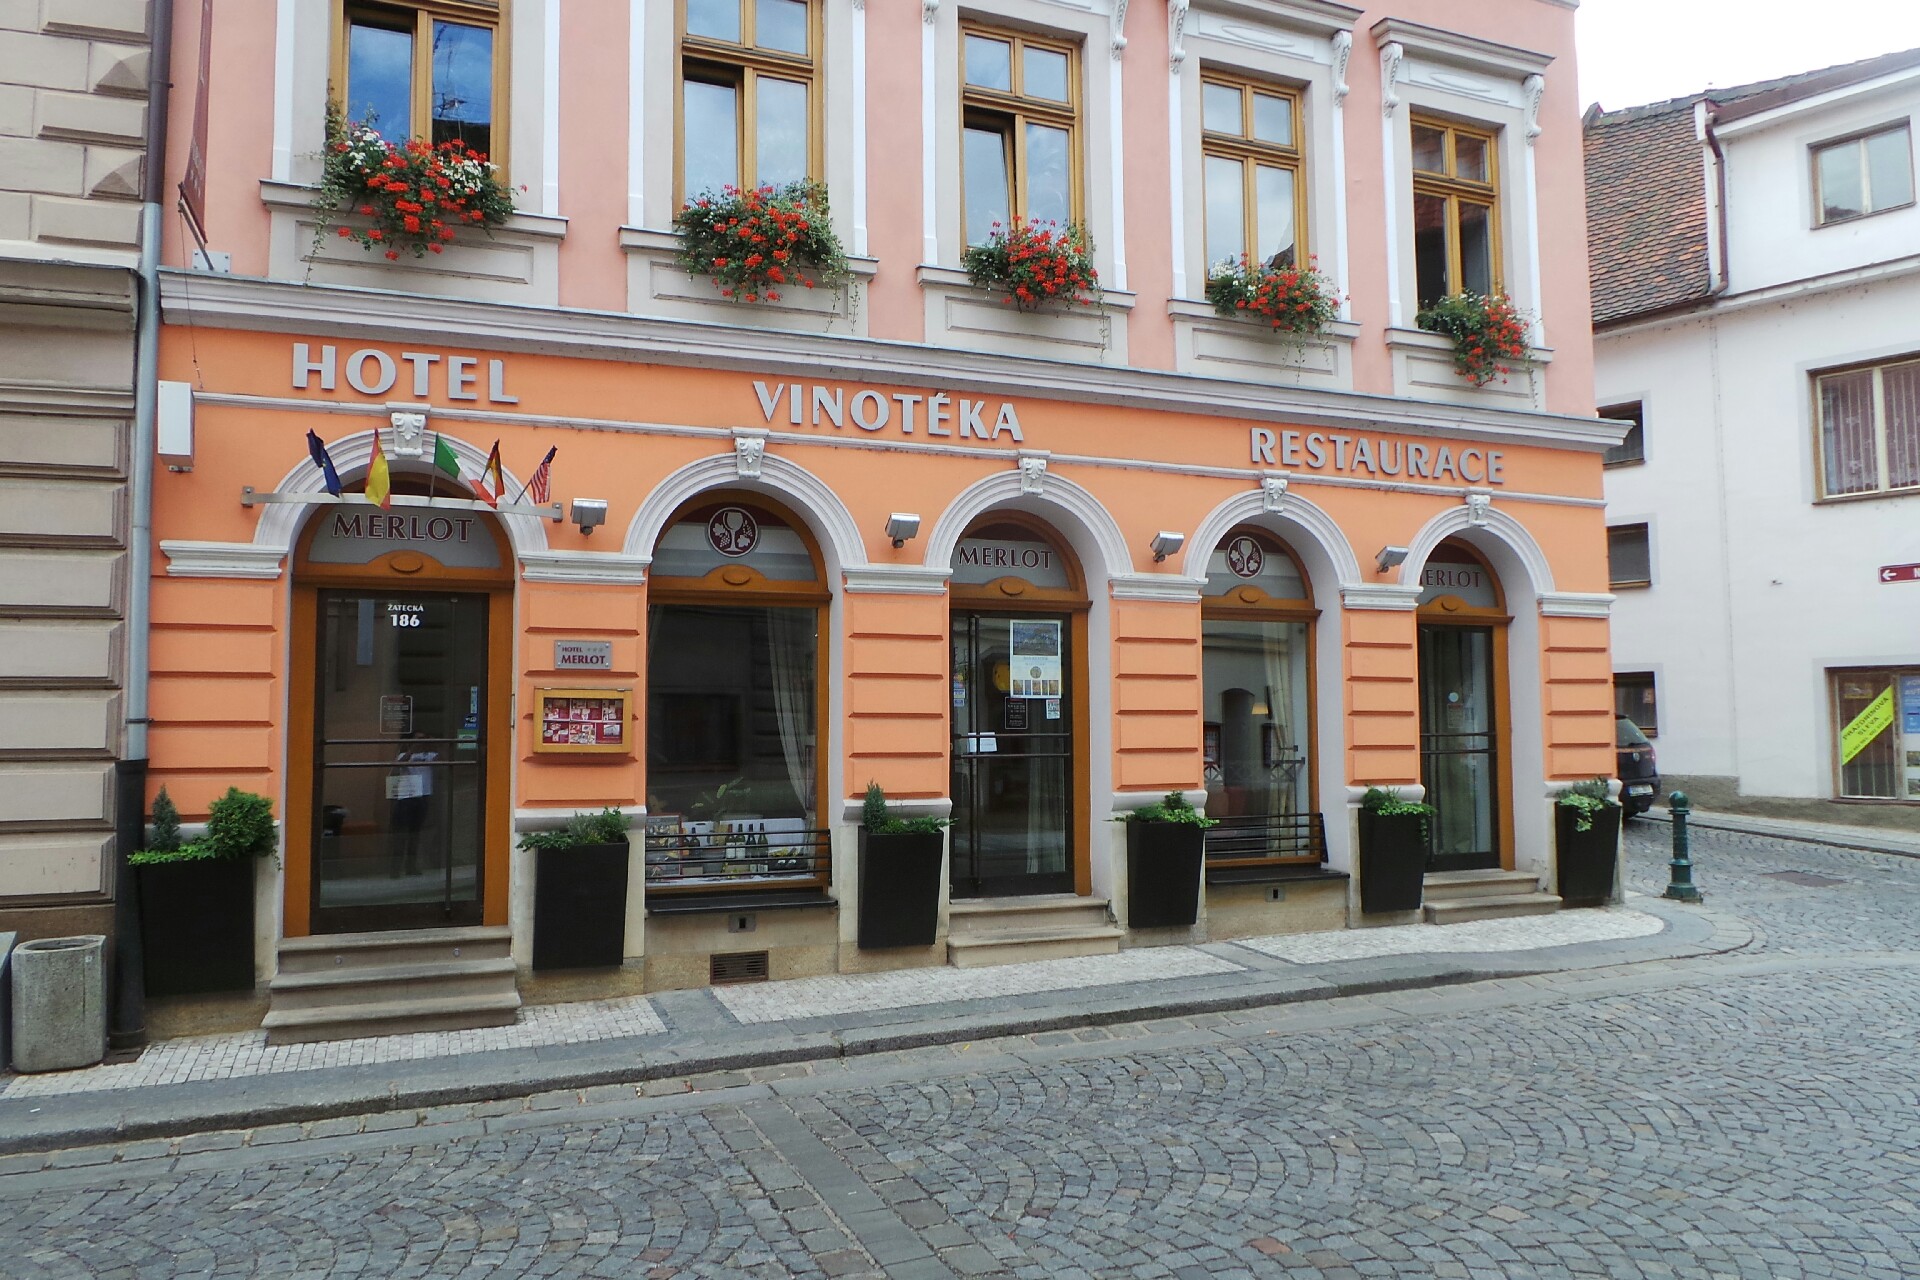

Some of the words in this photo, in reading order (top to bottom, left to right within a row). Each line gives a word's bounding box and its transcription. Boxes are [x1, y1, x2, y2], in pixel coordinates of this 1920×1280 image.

[292, 342, 519, 403] HOTEL
[753, 381, 1024, 441] VINOTÉKA
[1251, 427, 1504, 483] RESTAURACE
[332, 513, 473, 542] MERLOT
[959, 545, 1052, 569] MERLOT
[1419, 569, 1481, 588] ERLOT
[387, 603, 424, 612] ŽATECKÁ
[390, 614, 420, 627] 186
[561, 655, 606, 665] MERLOT
